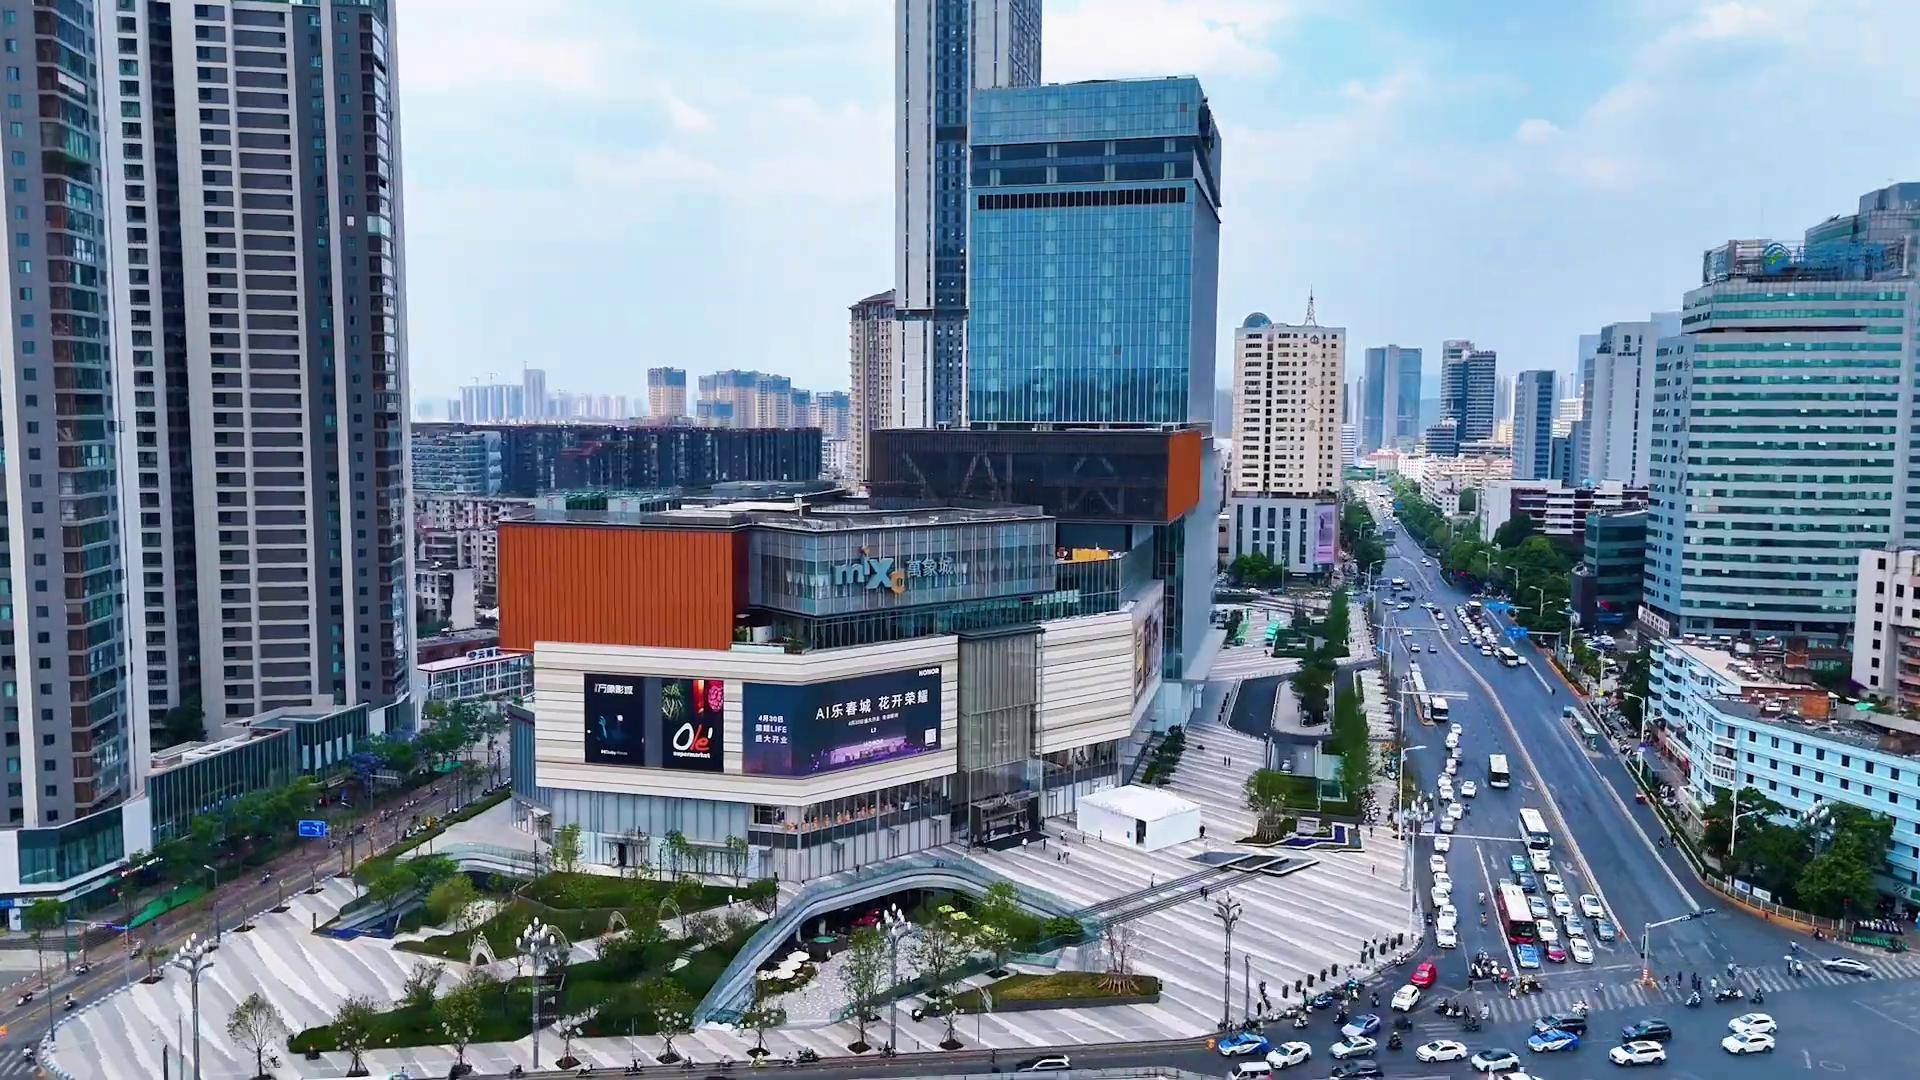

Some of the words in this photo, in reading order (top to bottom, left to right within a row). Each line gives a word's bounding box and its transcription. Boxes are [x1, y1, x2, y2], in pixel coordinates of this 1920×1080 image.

[906, 557, 955, 578] 萬象城
[918, 668, 940, 677] HONOR
[878, 689, 929, 711] 花开荣耀
[673, 751, 711, 759] supermarket
